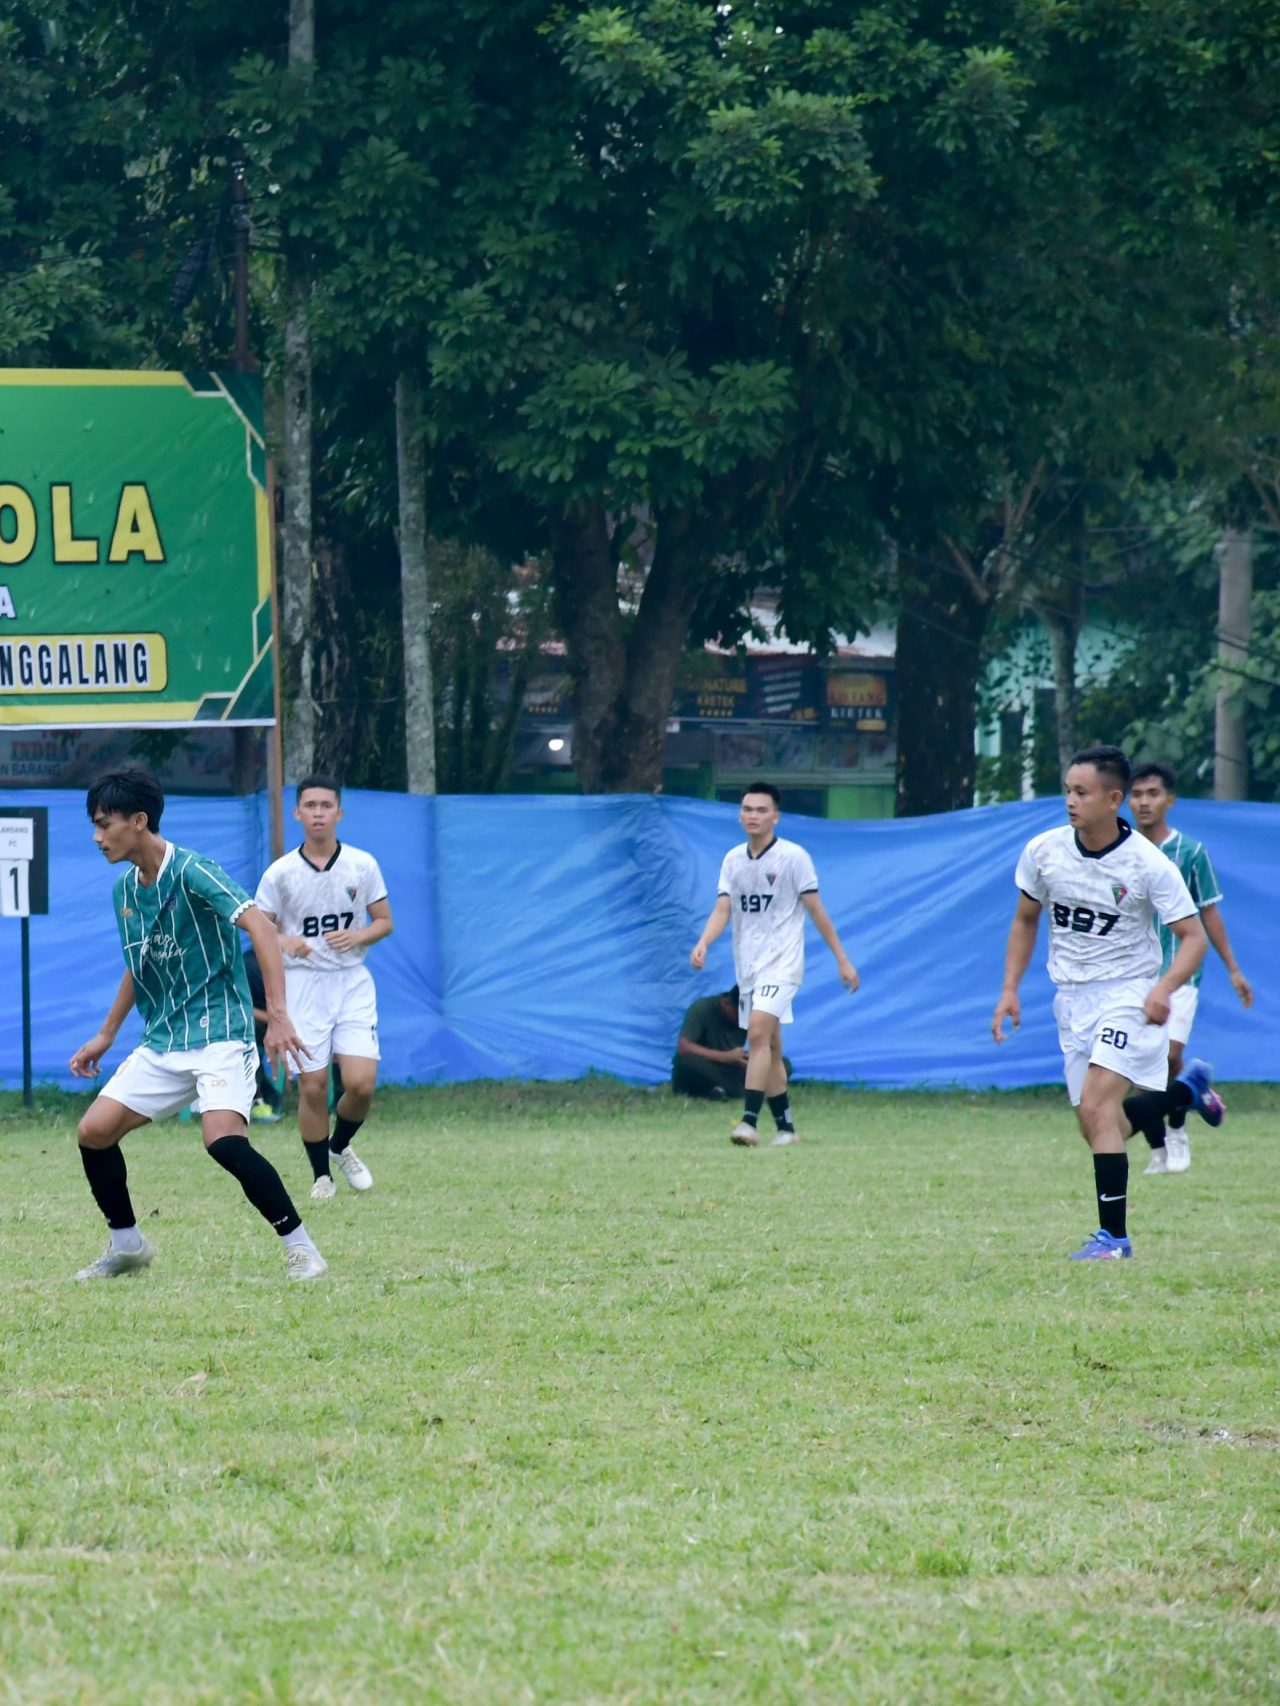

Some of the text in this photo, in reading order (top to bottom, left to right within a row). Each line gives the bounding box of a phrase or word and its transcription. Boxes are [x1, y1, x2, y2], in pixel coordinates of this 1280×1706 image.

[9, 866, 20, 911] 1
[740, 894, 774, 914] 897
[302, 911, 355, 938] 897
[1052, 902, 1121, 937] 897
[1100, 1026, 1129, 1051] 20
